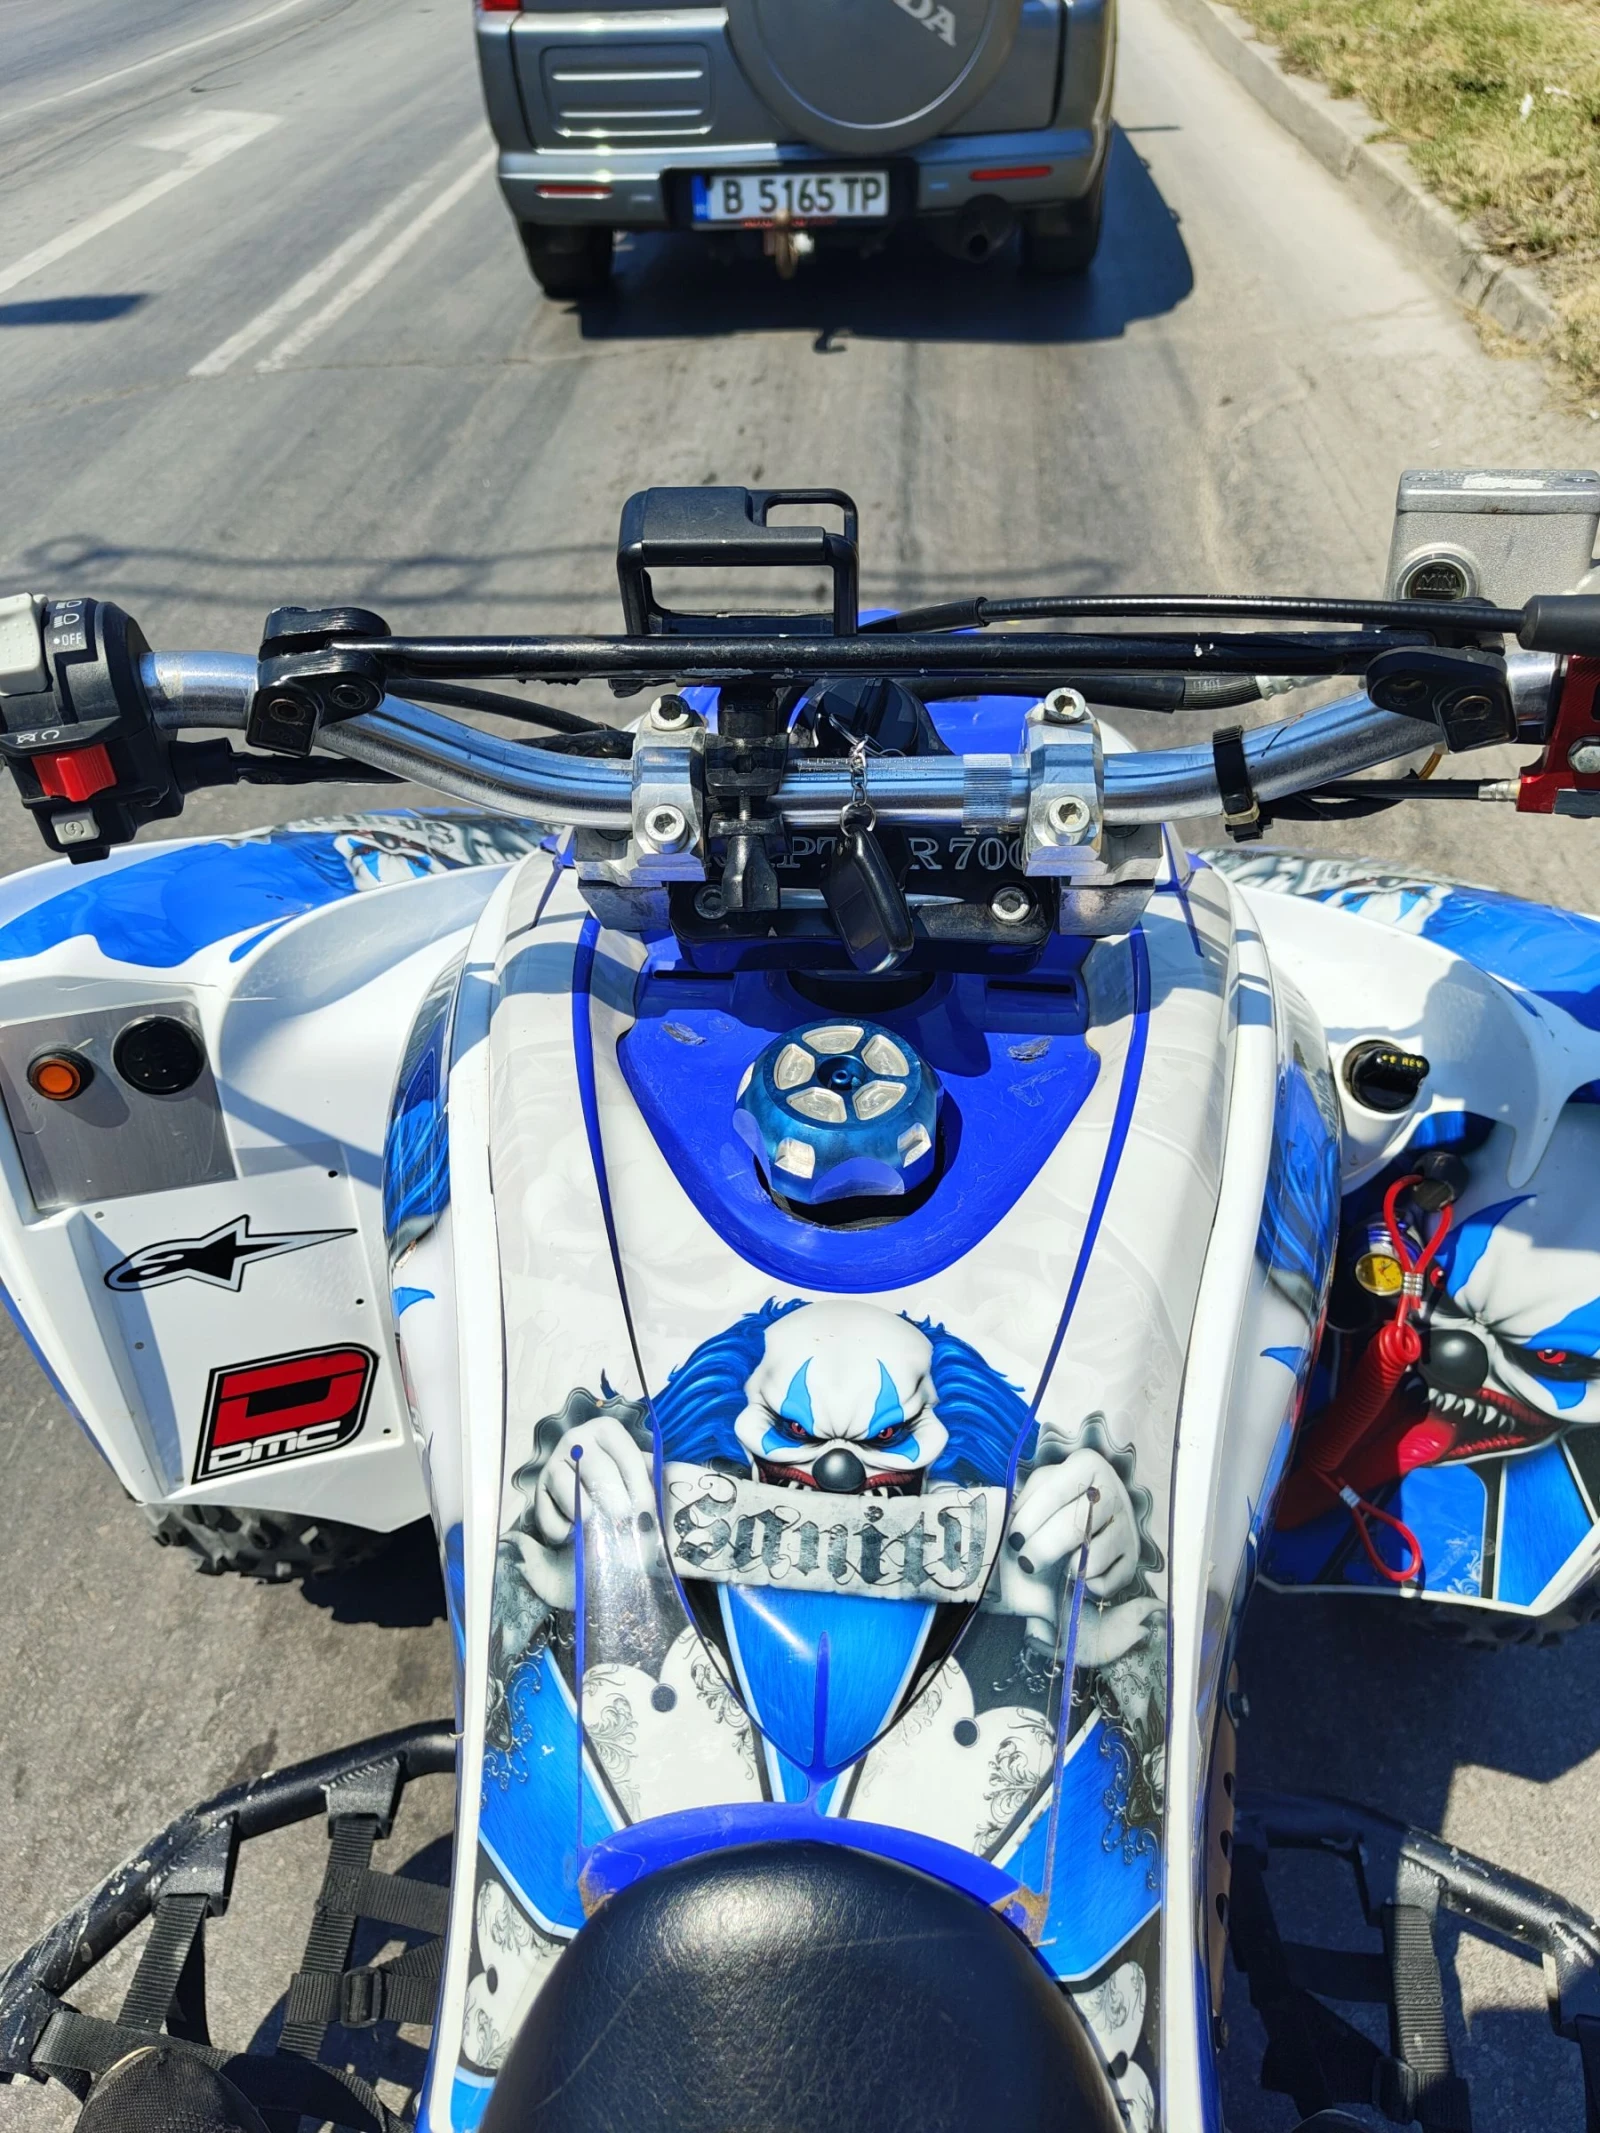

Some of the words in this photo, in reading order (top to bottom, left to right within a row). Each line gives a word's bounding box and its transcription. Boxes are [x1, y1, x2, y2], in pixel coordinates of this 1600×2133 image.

[722, 180, 744, 214] B
[759, 178, 835, 213] 5165
[842, 177, 882, 212] TP
[61, 632, 82, 646] OFF
[208, 1421, 341, 1471] DMC
